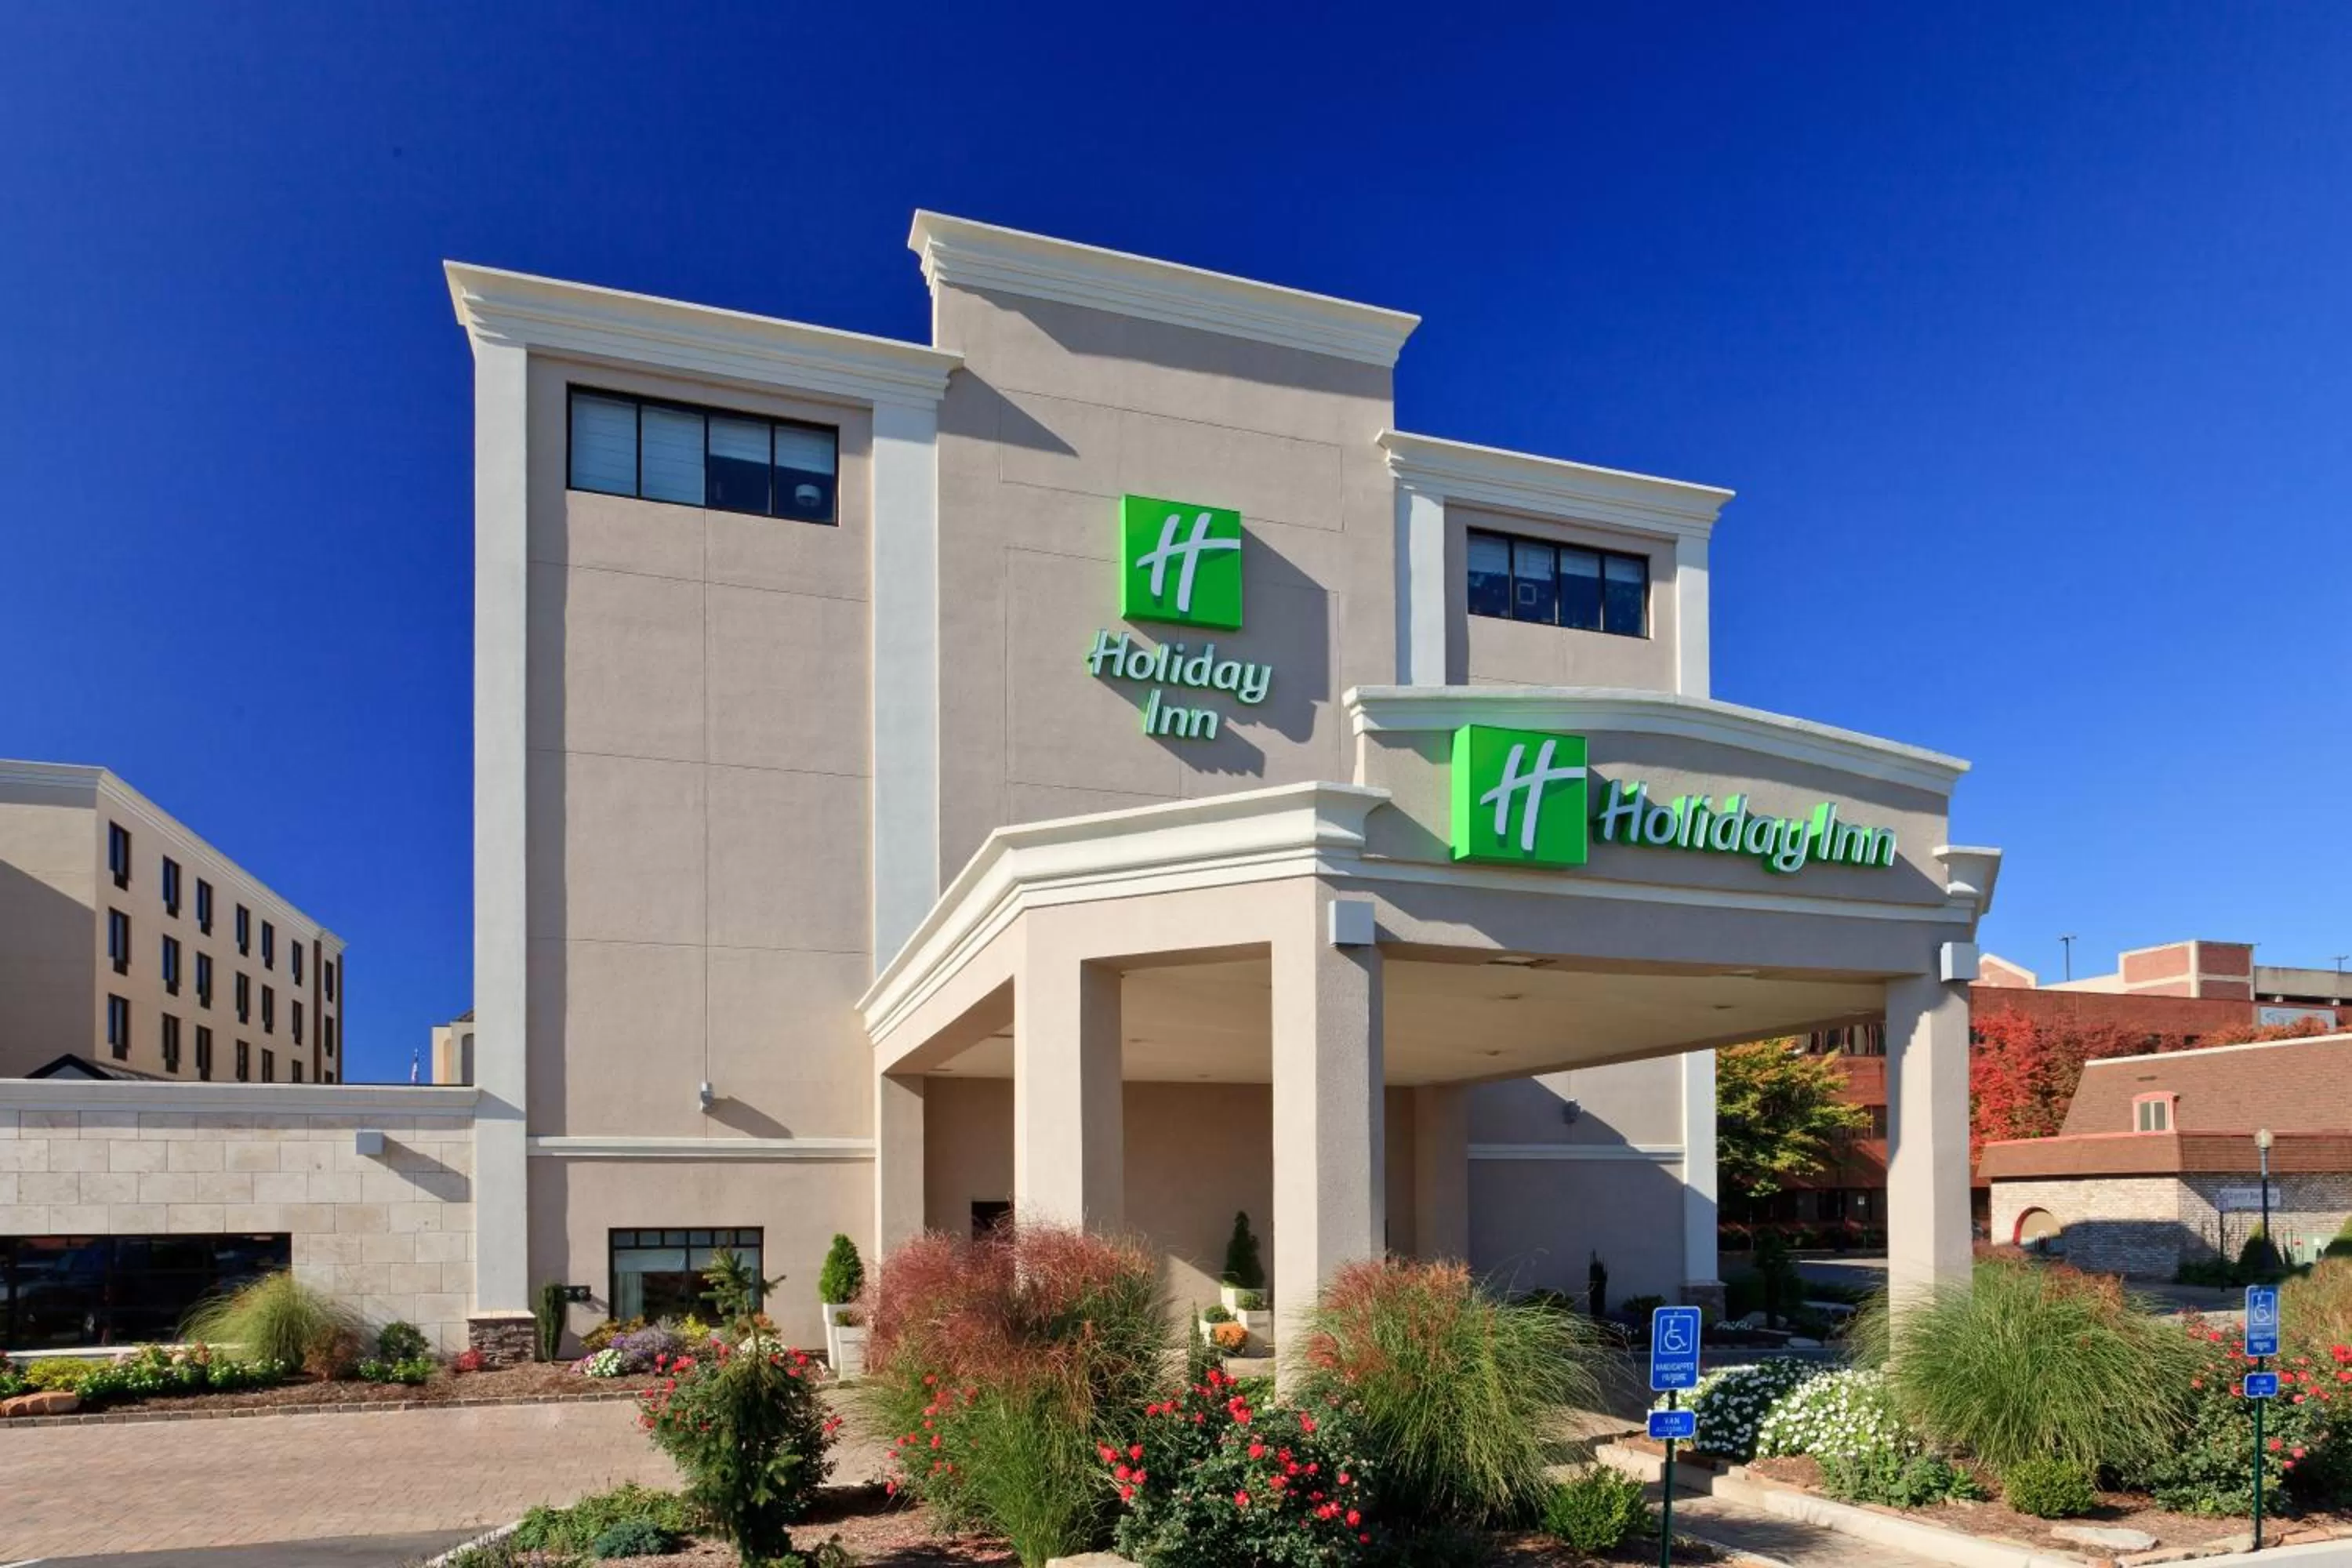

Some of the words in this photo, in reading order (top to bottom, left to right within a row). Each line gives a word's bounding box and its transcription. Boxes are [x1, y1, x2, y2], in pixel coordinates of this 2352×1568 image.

[1088, 628, 1272, 703] Holiday
[1144, 688, 1218, 740] Inn
[1596, 778, 1809, 873] Holiday
[1813, 801, 1896, 866] Inn
